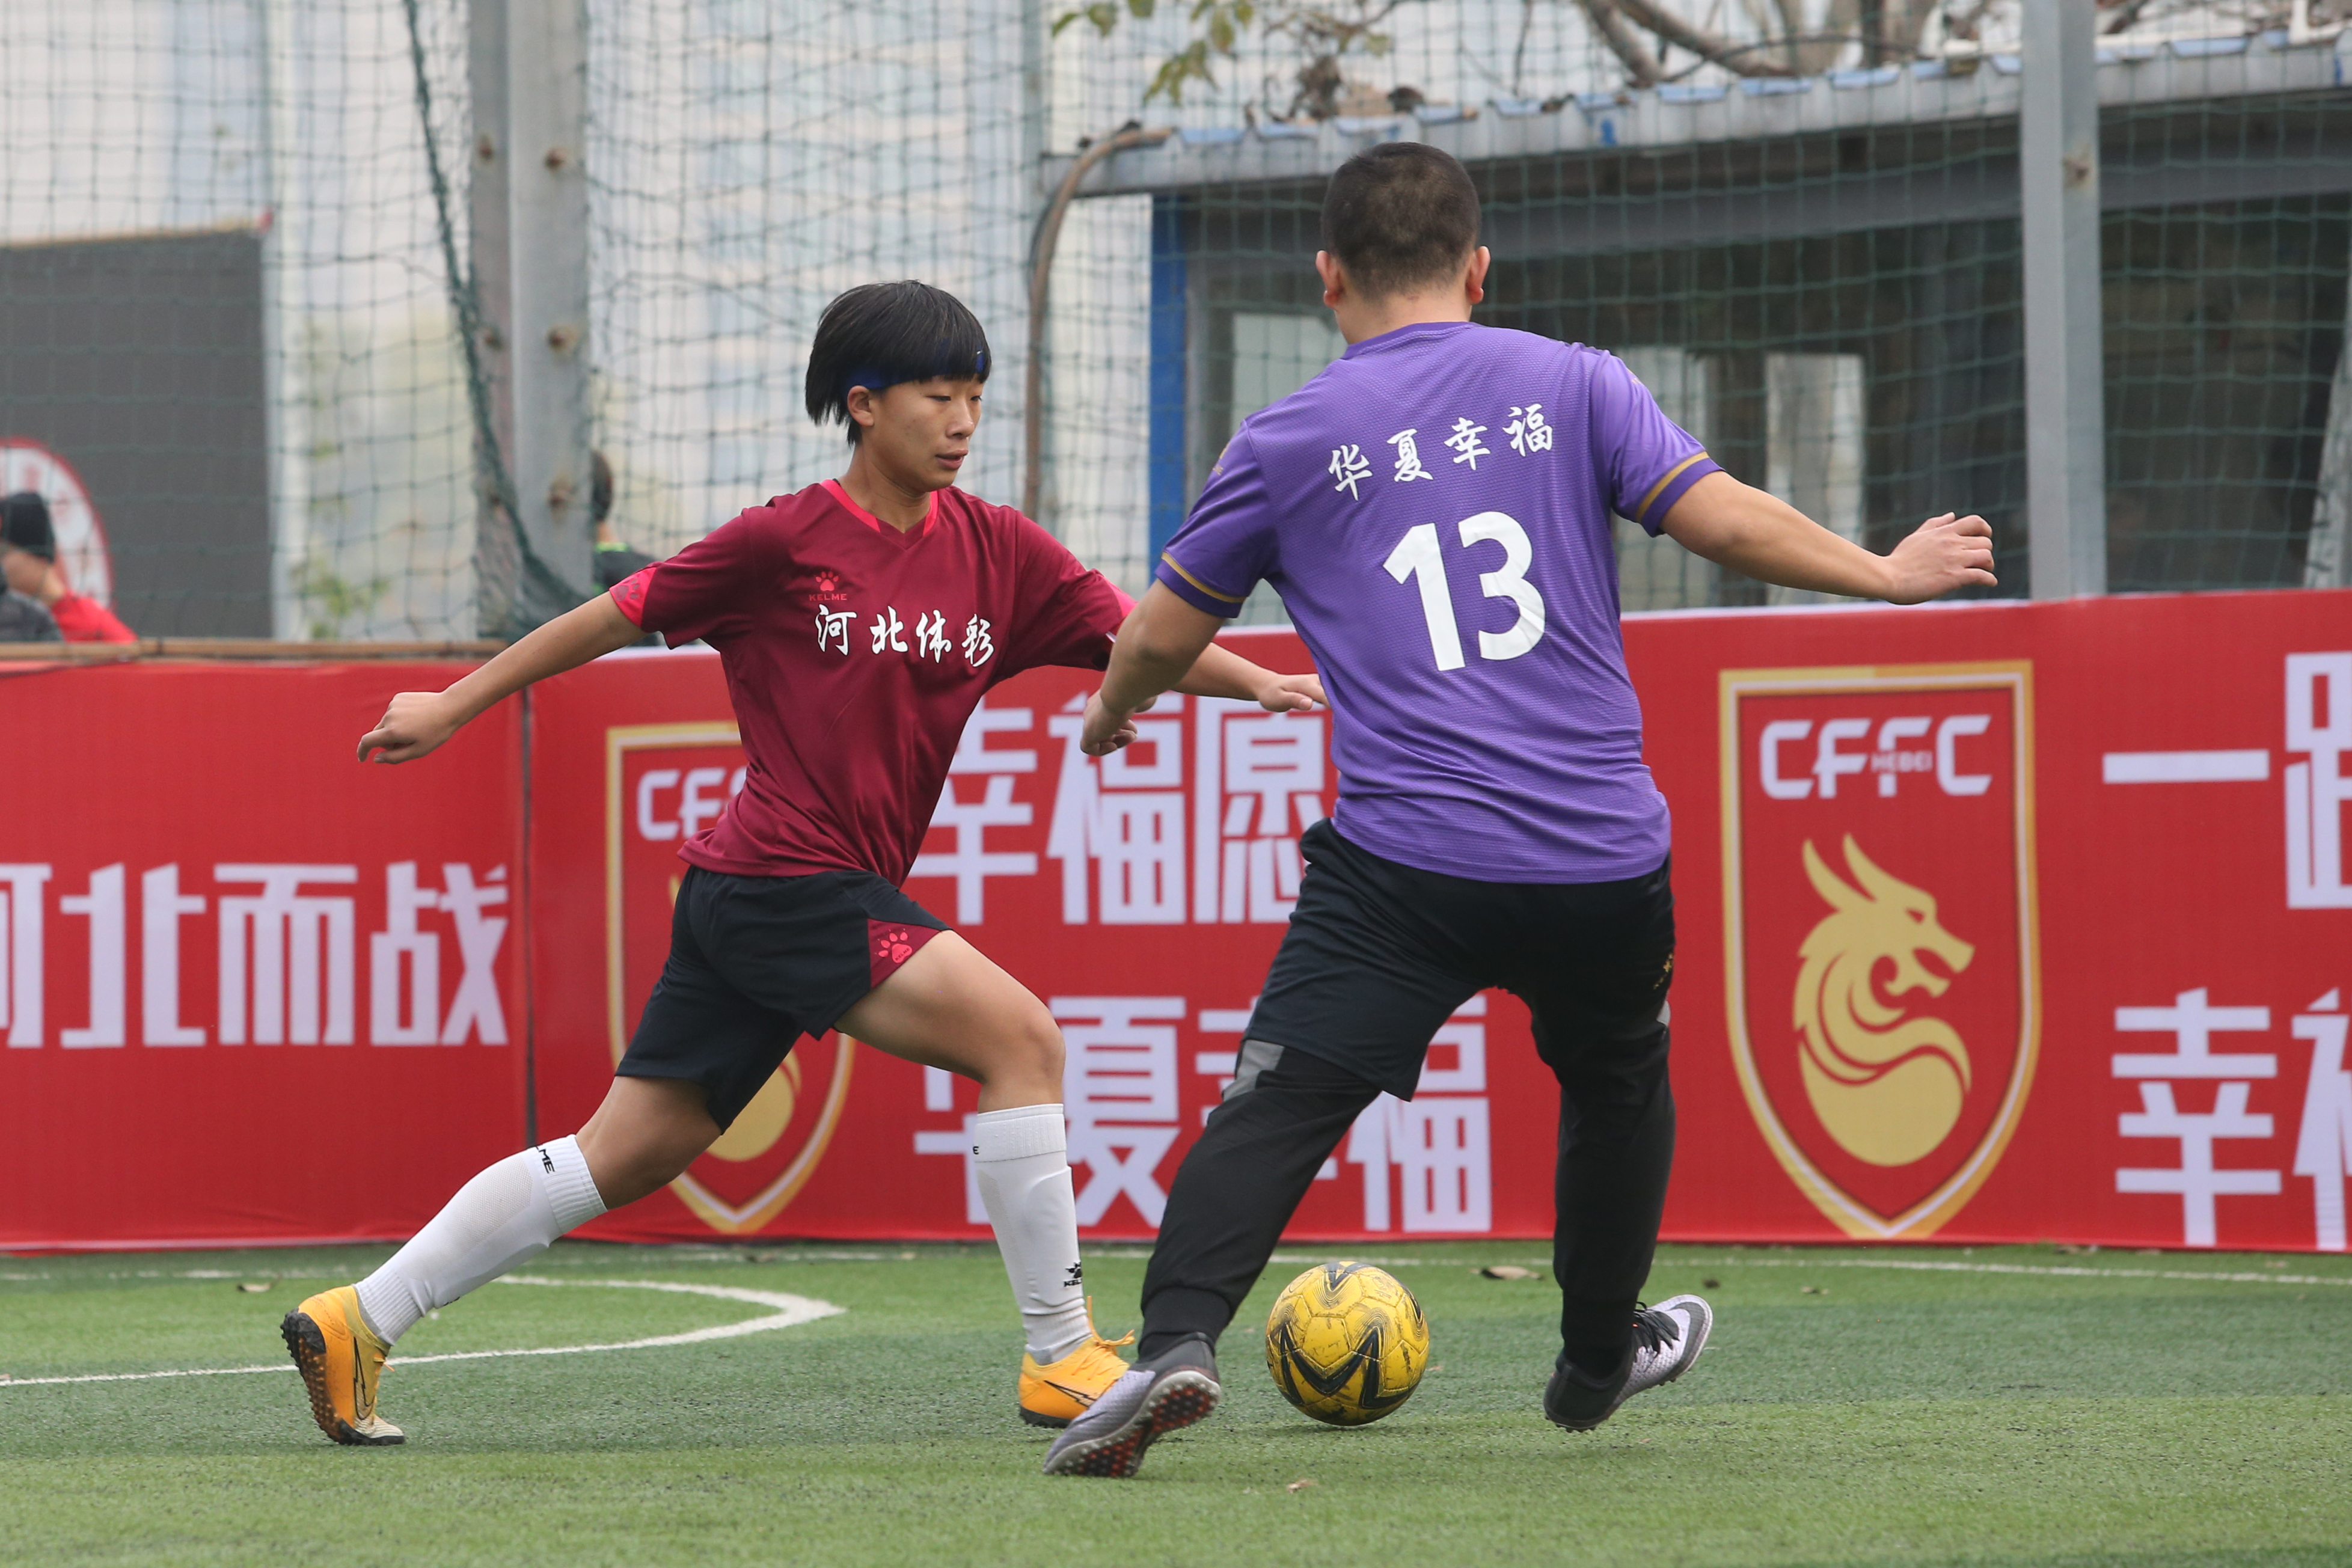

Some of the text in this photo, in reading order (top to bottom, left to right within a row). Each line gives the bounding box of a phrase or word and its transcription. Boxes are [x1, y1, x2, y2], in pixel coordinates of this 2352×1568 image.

[1328, 403, 1554, 501] 华夏幸福
[809, 593, 847, 601] KELME
[1382, 511, 1546, 671] 13
[815, 604, 995, 667] 河北体彩
[1759, 714, 1992, 800] CFFC
[895, 948, 910, 961] KELME
